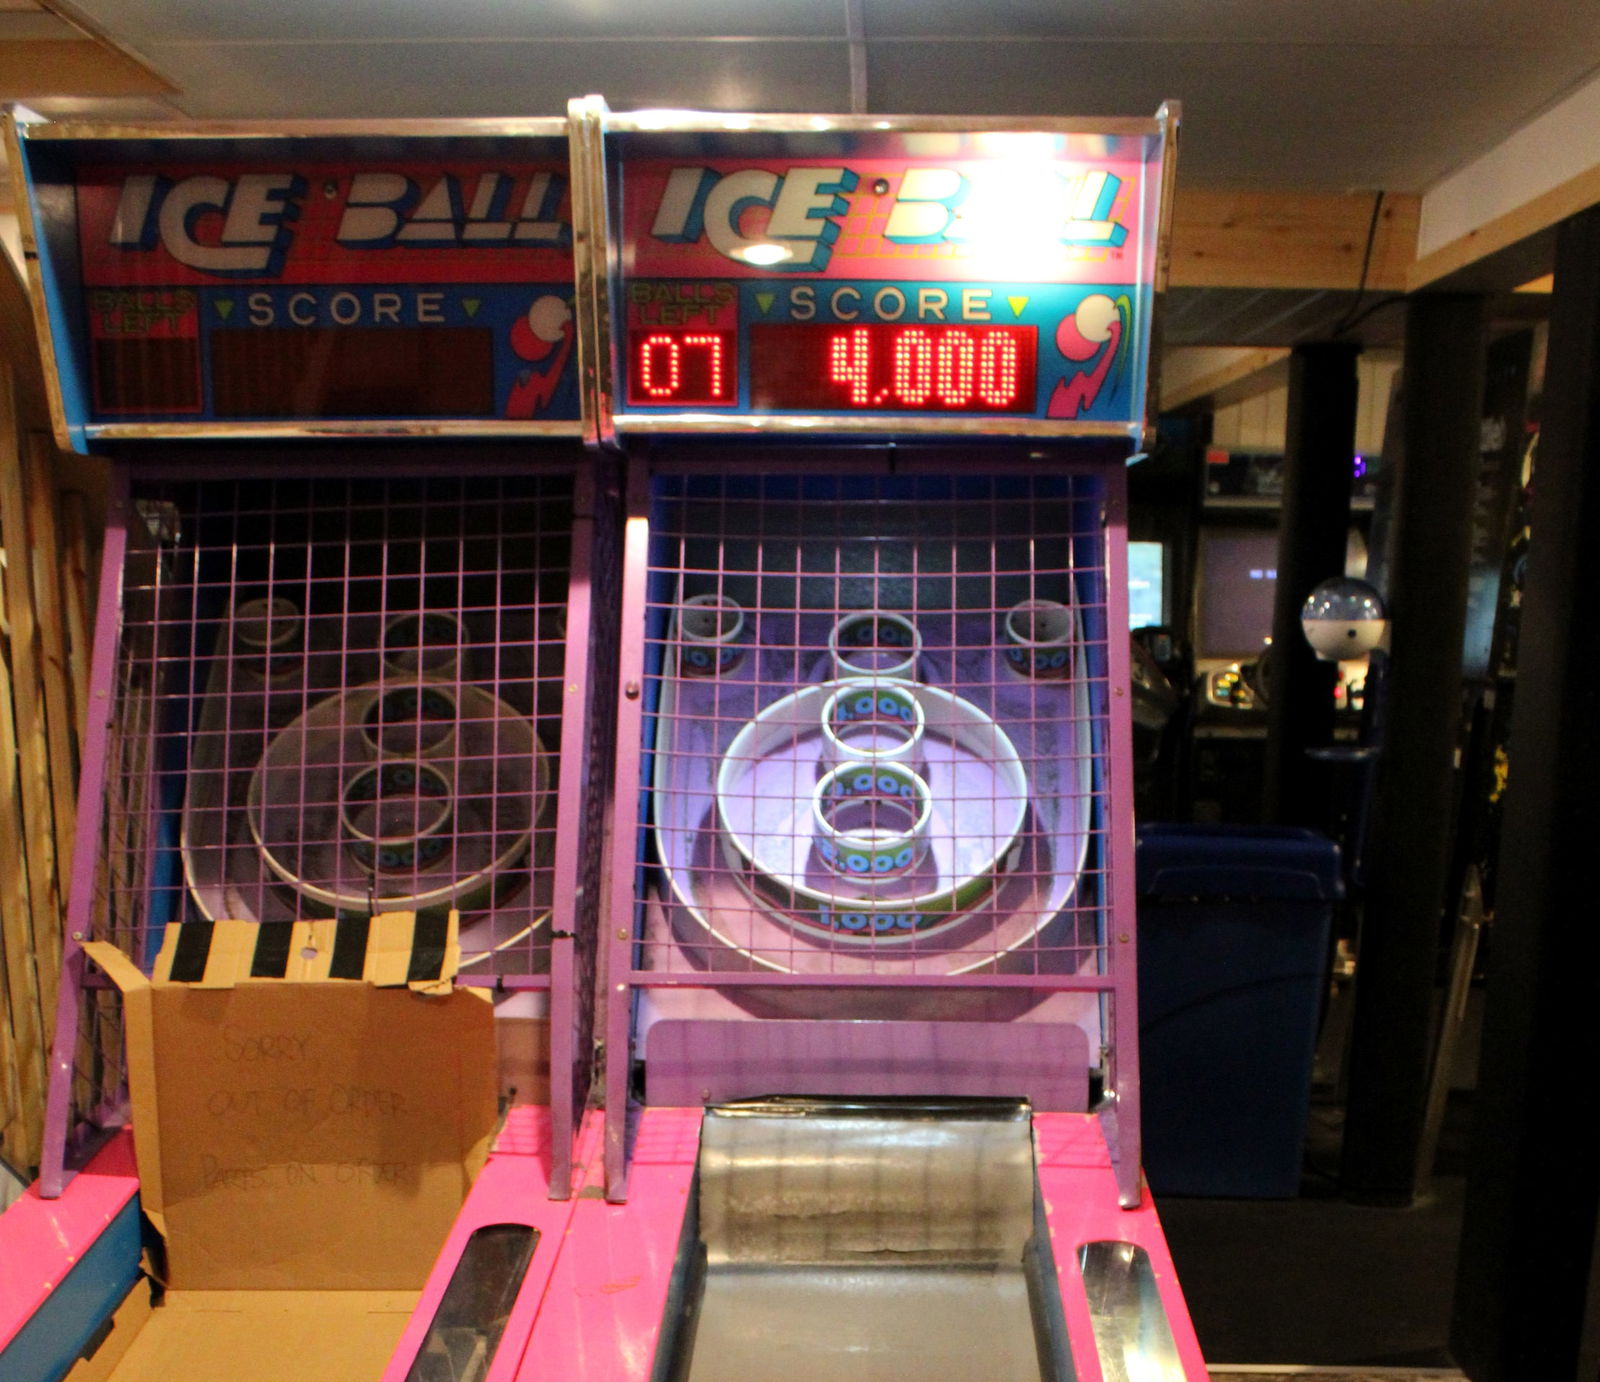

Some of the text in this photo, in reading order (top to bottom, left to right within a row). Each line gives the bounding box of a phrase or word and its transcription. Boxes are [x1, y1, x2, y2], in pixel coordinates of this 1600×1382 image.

[109, 172, 570, 279] ICE BALL
[651, 167, 1129, 273] ICE BL
[248, 292, 447, 326] SCORE
[631, 282, 733, 304] BALLS
[790, 286, 994, 322] SCORE
[103, 312, 178, 335] LEFT
[639, 304, 720, 325] LEFT
[641, 335, 722, 398] 07
[207, 1089, 266, 1117] OUT
